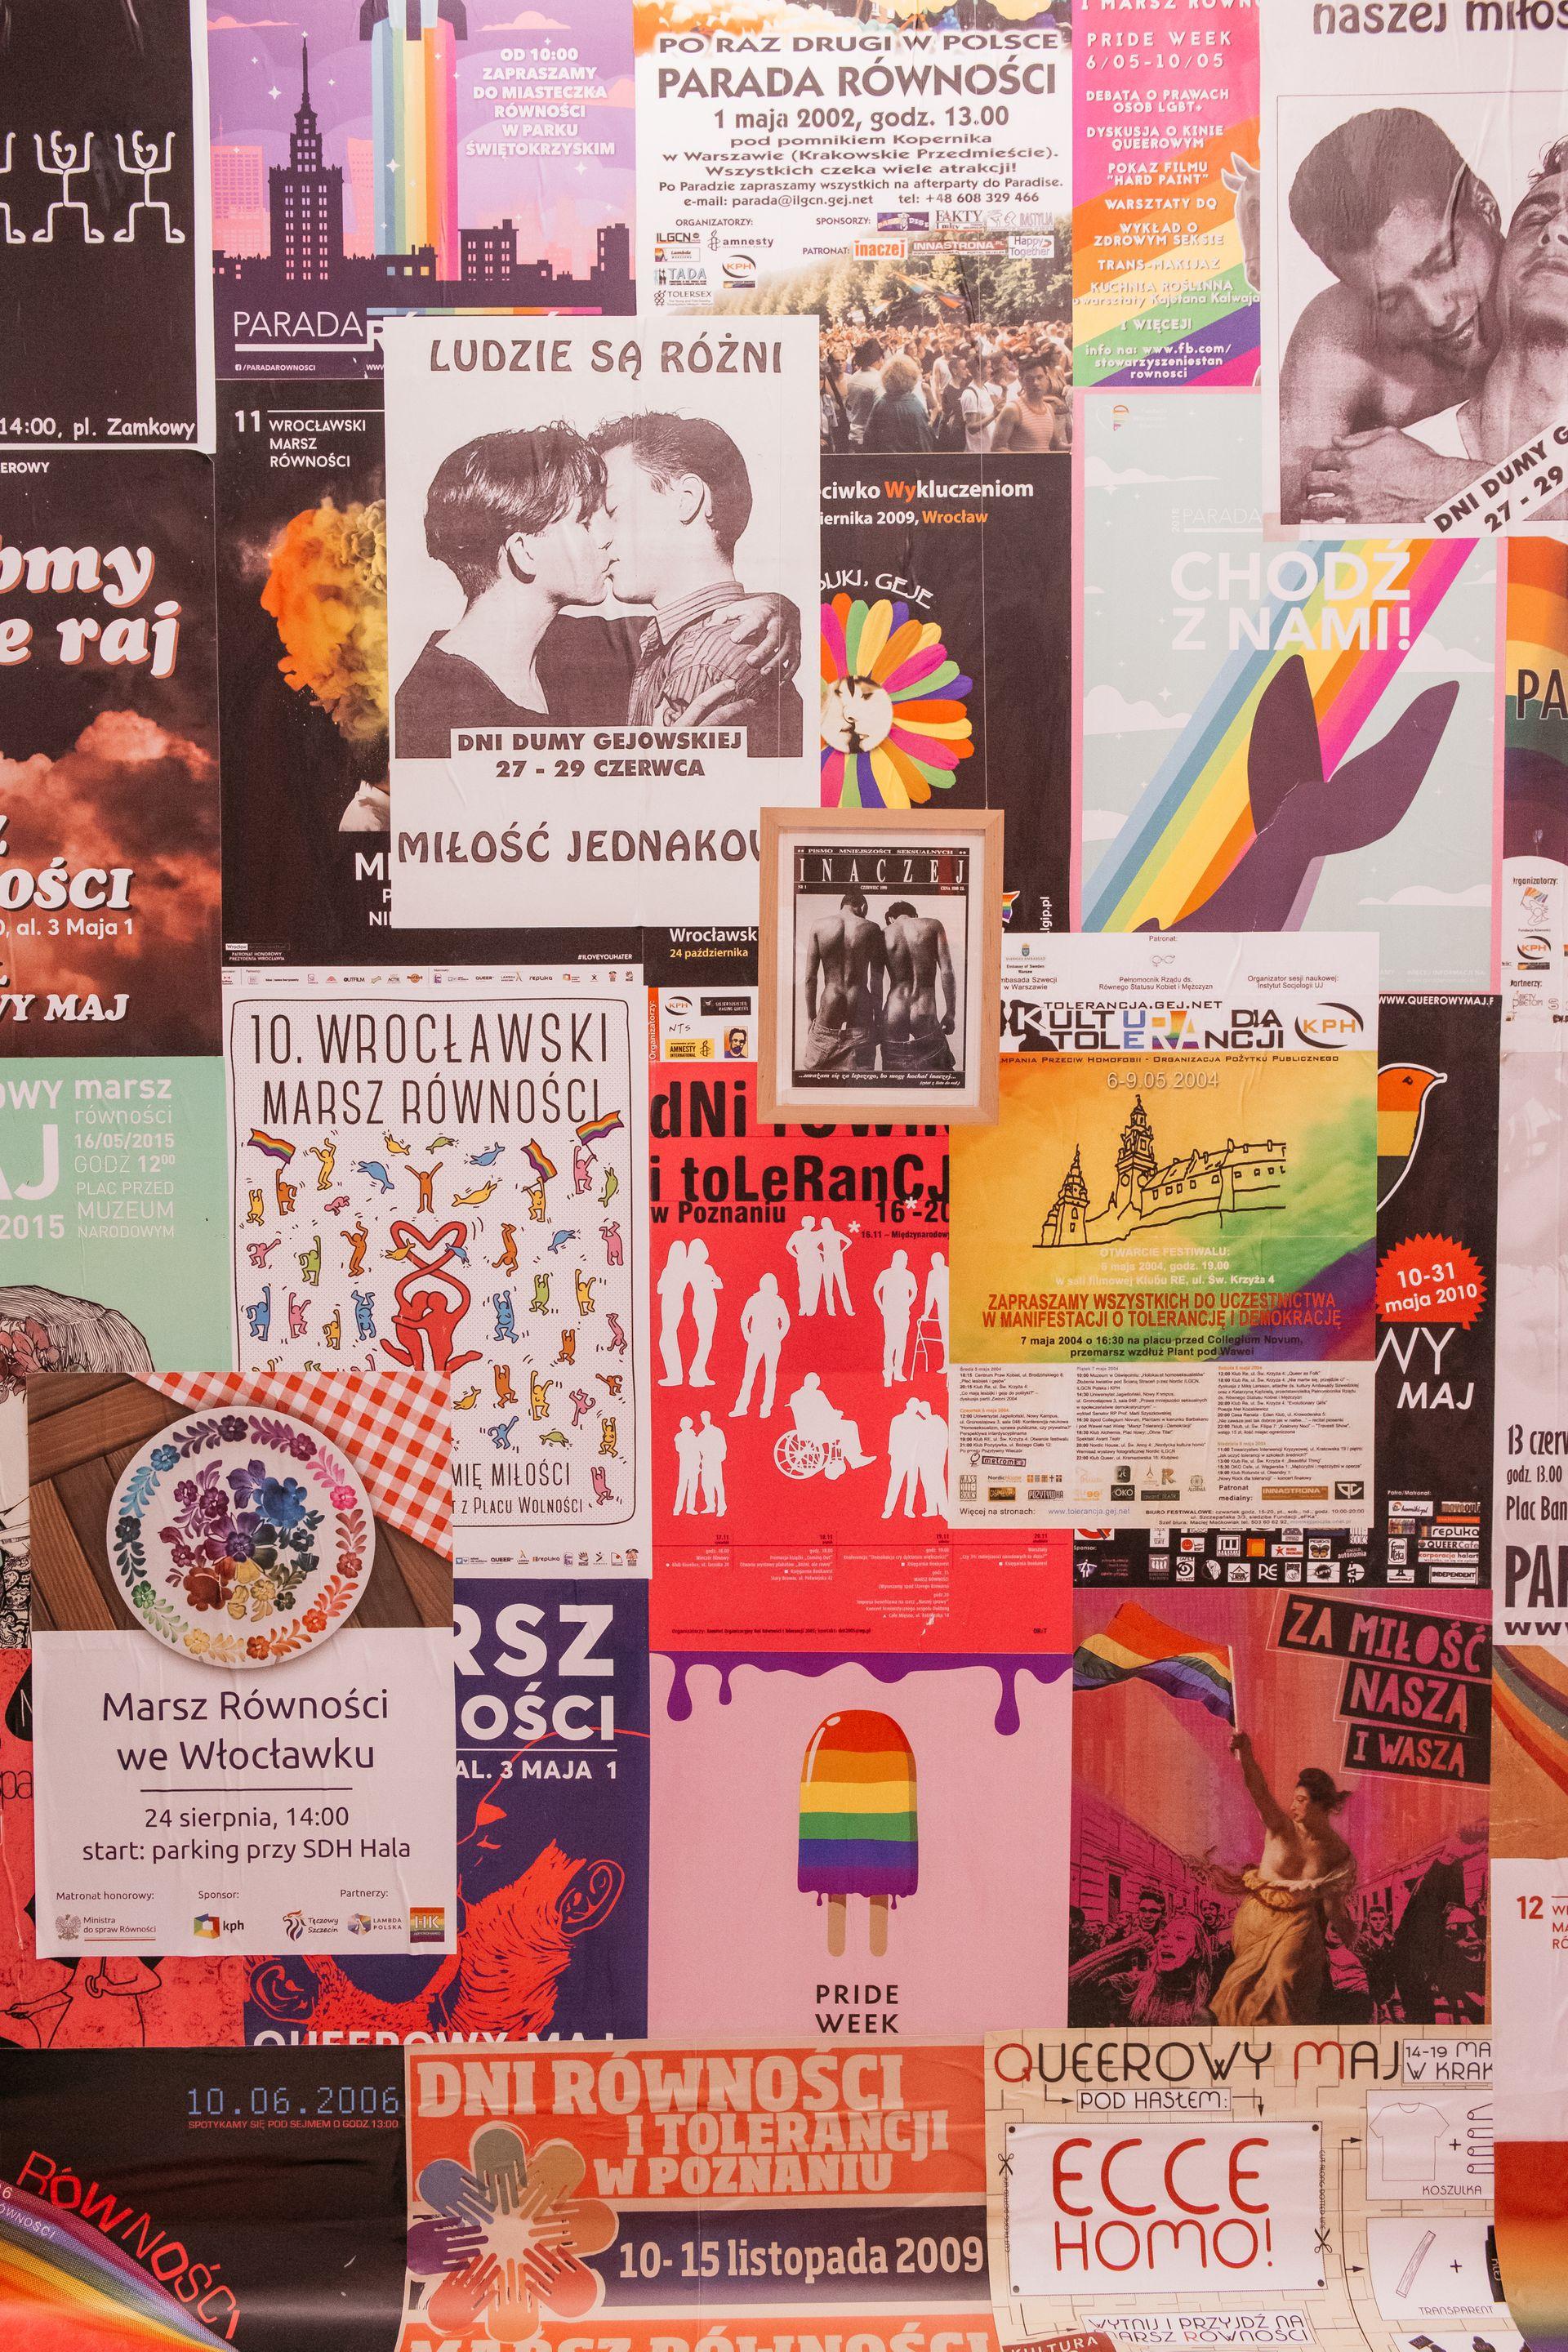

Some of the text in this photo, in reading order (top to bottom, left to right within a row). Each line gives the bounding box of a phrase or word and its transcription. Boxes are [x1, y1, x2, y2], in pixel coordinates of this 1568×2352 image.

[660, 34, 1058, 53] PO RAZ DRUGI W POLSCE
[1088, 31, 1230, 47] PRIDE WEEK
[501, 48, 578, 60] OD 10:00
[1086, 53, 1223, 69] 6/05-10/05
[483, 67, 597, 79] ZAPRASZAMY
[659, 55, 1054, 98] PARADA RÓWNOŚCI
[474, 86, 608, 99] DO MIASTECZKA
[495, 102, 585, 118] RÓWNOŚCI
[715, 109, 723, 128] 1
[736, 109, 787, 132] maja
[797, 108, 862, 131] 2002,
[871, 107, 934, 131] godz.
[466, 140, 615, 158] ŚWIĘTOKRZYSKIM
[731, 134, 991, 148] pod pomnikiem Kopernika
[1109, 162, 1207, 173] POKAZ FILMU
[1105, 198, 1190, 209] WARSZTATY
[675, 219, 754, 227] ORGANIZATORZY:
[816, 217, 871, 225] SPONSORZY:
[855, 240, 906, 260] inaczej
[234, 311, 363, 336] PARADA
[430, 332, 781, 381] LUDZIE SĄ RÓŻNI
[0, 417, 195, 441] 14:00, pl. Zamkowy
[235, 411, 365, 432] 11 WROCŁAWSKI
[270, 438, 317, 449] MARSZ
[270, 452, 350, 467] RÓWNOŚCI
[884, 479, 1034, 503] Wykluczeniom
[877, 510, 988, 526] 2009, Wrocław
[1183, 508, 1262, 524] PARADA
[1171, 540, 1411, 602] CHODŹ
[875, 573, 933, 608] GEJE
[56, 600, 181, 679] raj
[1172, 608, 1410, 651] Z NAMI!
[458, 732, 741, 751] DNI DUMY GEJOWSKIEJ
[497, 761, 527, 777] 27
[555, 760, 585, 777] 29
[595, 760, 705, 777] CZERWCA
[399, 822, 549, 862] MIŁOŚĆ
[800, 858, 964, 883] INACZEJ
[17, 918, 131, 939] al. 3 Maja 1
[44, 994, 129, 1021] MAJ
[1044, 1001, 1222, 1009] TOLERANCJA.GEJ.NET
[648, 1000, 658, 1060] Organizatorzy:
[1304, 1020, 1355, 1033] KPH
[252, 1013, 606, 1063] 10. WROCŁAWSKI
[75, 1080, 172, 1099] marsz
[1107, 1071, 1218, 1090] 6-9.05.2004
[264, 1071, 599, 1125] MARSZ RÓWNOŚCI
[76, 1104, 171, 1124] równości
[75, 1132, 174, 1150] 16/05/2015
[75, 1156, 130, 1173] GODZ
[78, 1201, 173, 1218] MUZEUM
[651, 1200, 786, 1223] w Poznaniu
[78, 1225, 174, 1238] NARODOWYM
[1397, 1263, 1454, 1288] 10-31
[988, 1293, 1335, 1310] ZAPRASZAMY WSZYSTKICH DO UCZESTNICTWA
[1386, 1284, 1477, 1312] maja 2010
[1397, 1382, 1474, 1410] MAJ
[1508, 1424, 1523, 1454] 13
[492, 1459, 569, 1486] MIŁOŚCI
[1507, 1465, 1561, 1485] godz. 13.00
[1507, 1496, 1535, 1521] Plac
[1286, 1601, 1487, 1673] ZA MIŁOŚĆ
[104, 1688, 387, 1721] Marsz Równości
[1351, 1668, 1468, 1732] NASZĄ
[117, 1737, 373, 1771] we Włocławku
[1353, 1731, 1464, 1777] I WASZĄ
[455, 1760, 616, 1780] AL. 3 MAJA 1
[145, 1807, 348, 1831] 24 sierpnia, 14:00
[83, 1838, 409, 1864] start: parking przy SDH Hala
[56, 1890, 154, 1902] Matronat honorowy:
[198, 1890, 238, 1901] Sponsor:
[340, 1888, 389, 1900] Partnerzy:
[224, 1920, 244, 1933] kph
[817, 1984, 898, 2004] PRIDE
[815, 2014, 898, 2033] WEEK
[995, 2040, 1398, 2082] QUEEROWY MAJ
[417, 2048, 906, 2117] DNI RÓWNOŚCI
[189, 2087, 398, 2114] 10.06.2006
[1081, 2091, 1228, 2109] POD HASŁEM:
[626, 2109, 952, 2162] I TOLERANCJI
[594, 2153, 893, 2194] W POZNANIU
[1053, 2138, 1269, 2216] ECCE
[1423, 2185, 1481, 2195] KOSZULKA
[16, 2151, 240, 2339] RÓWNOŚCI
[1055, 2218, 1272, 2271] HOMO!
[682, 2242, 719, 2277] 15
[728, 2237, 889, 2284] listopada
[896, 2235, 984, 2274] 2009
